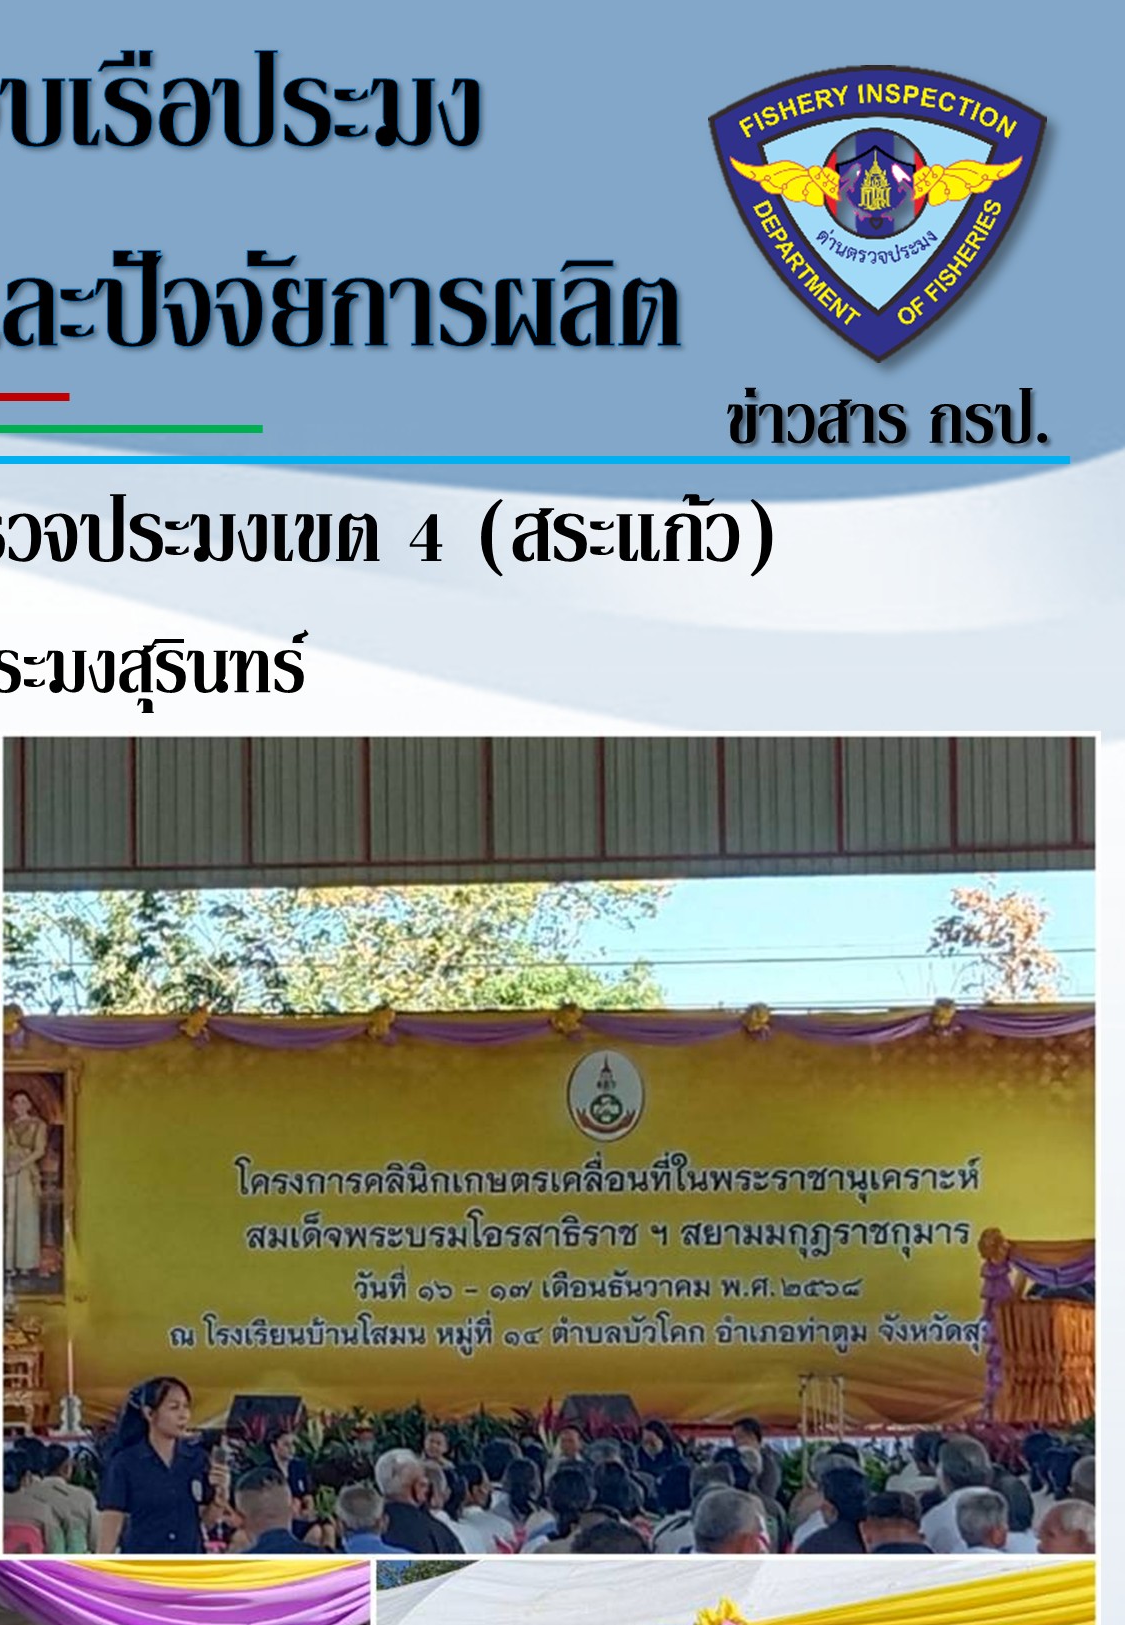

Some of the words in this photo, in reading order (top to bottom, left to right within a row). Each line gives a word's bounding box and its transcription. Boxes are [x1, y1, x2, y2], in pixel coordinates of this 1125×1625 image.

[235, 1152, 982, 1204] โครงการคลินิกเกษตรเคลื่อนที่ในพระราชานุเคราะห์
[246, 1208, 639, 1250] สมเด็จพระบรมโอรสาธิราช
[354, 1266, 407, 1301] วันที่
[542, 1269, 711, 1302] เดือนธันวาคม
[170, 1327, 194, 1347] ณ
[202, 1312, 427, 1348] โรงเรียนบ้านโสมน
[436, 1309, 492, 1358] หมู่ที่
[552, 1311, 705, 1346] ตำบลบัวโคก
[715, 1313, 868, 1354] อำเภอท่าตูม
